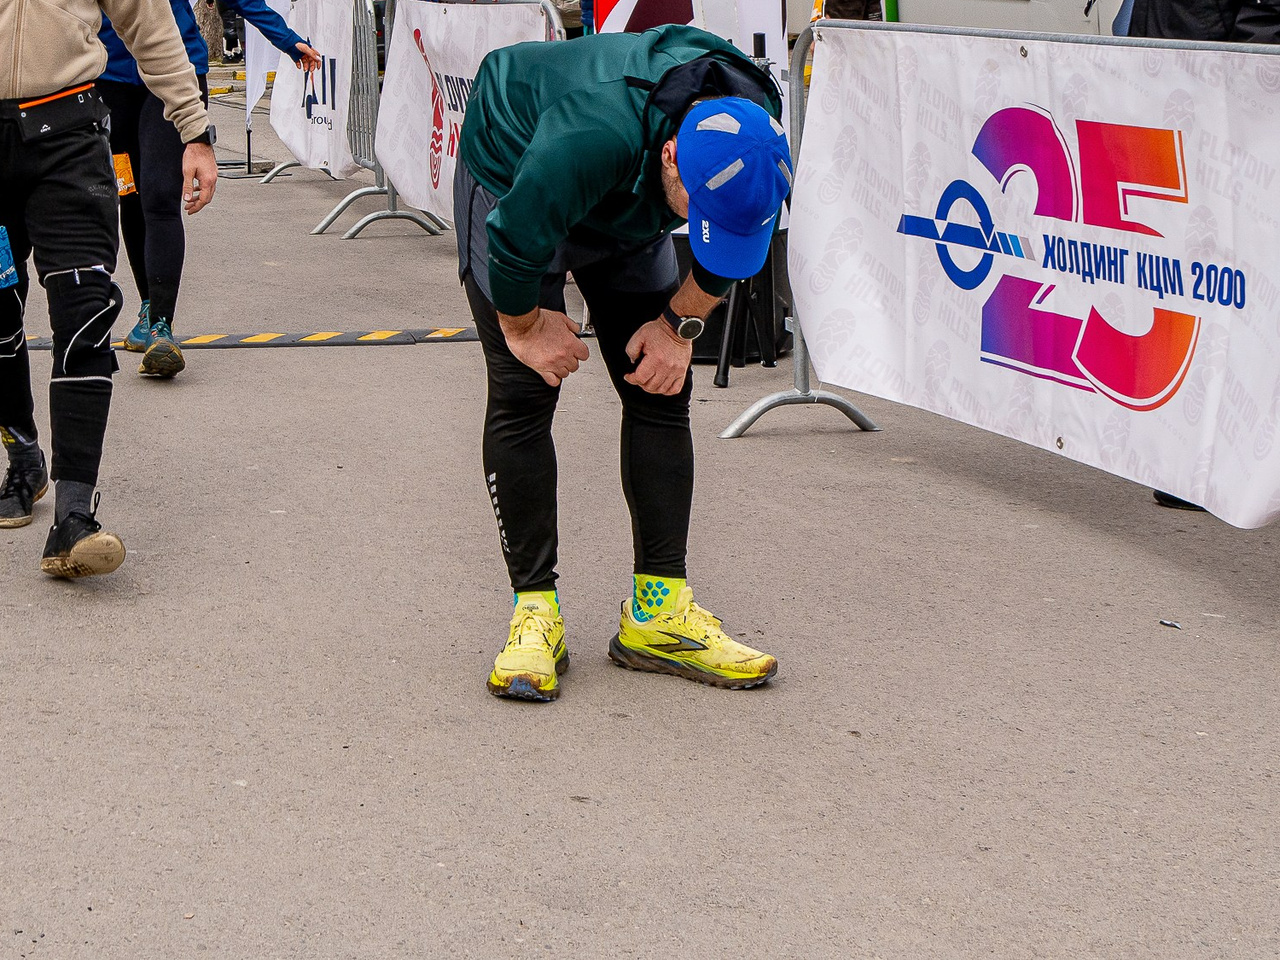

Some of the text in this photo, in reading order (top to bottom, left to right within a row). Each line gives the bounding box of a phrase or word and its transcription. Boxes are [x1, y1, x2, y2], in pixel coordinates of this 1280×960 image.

[702, 220, 710, 243] 2XU
[1042, 234, 1247, 310] ХОЛДИНГ КЦМ 2000
